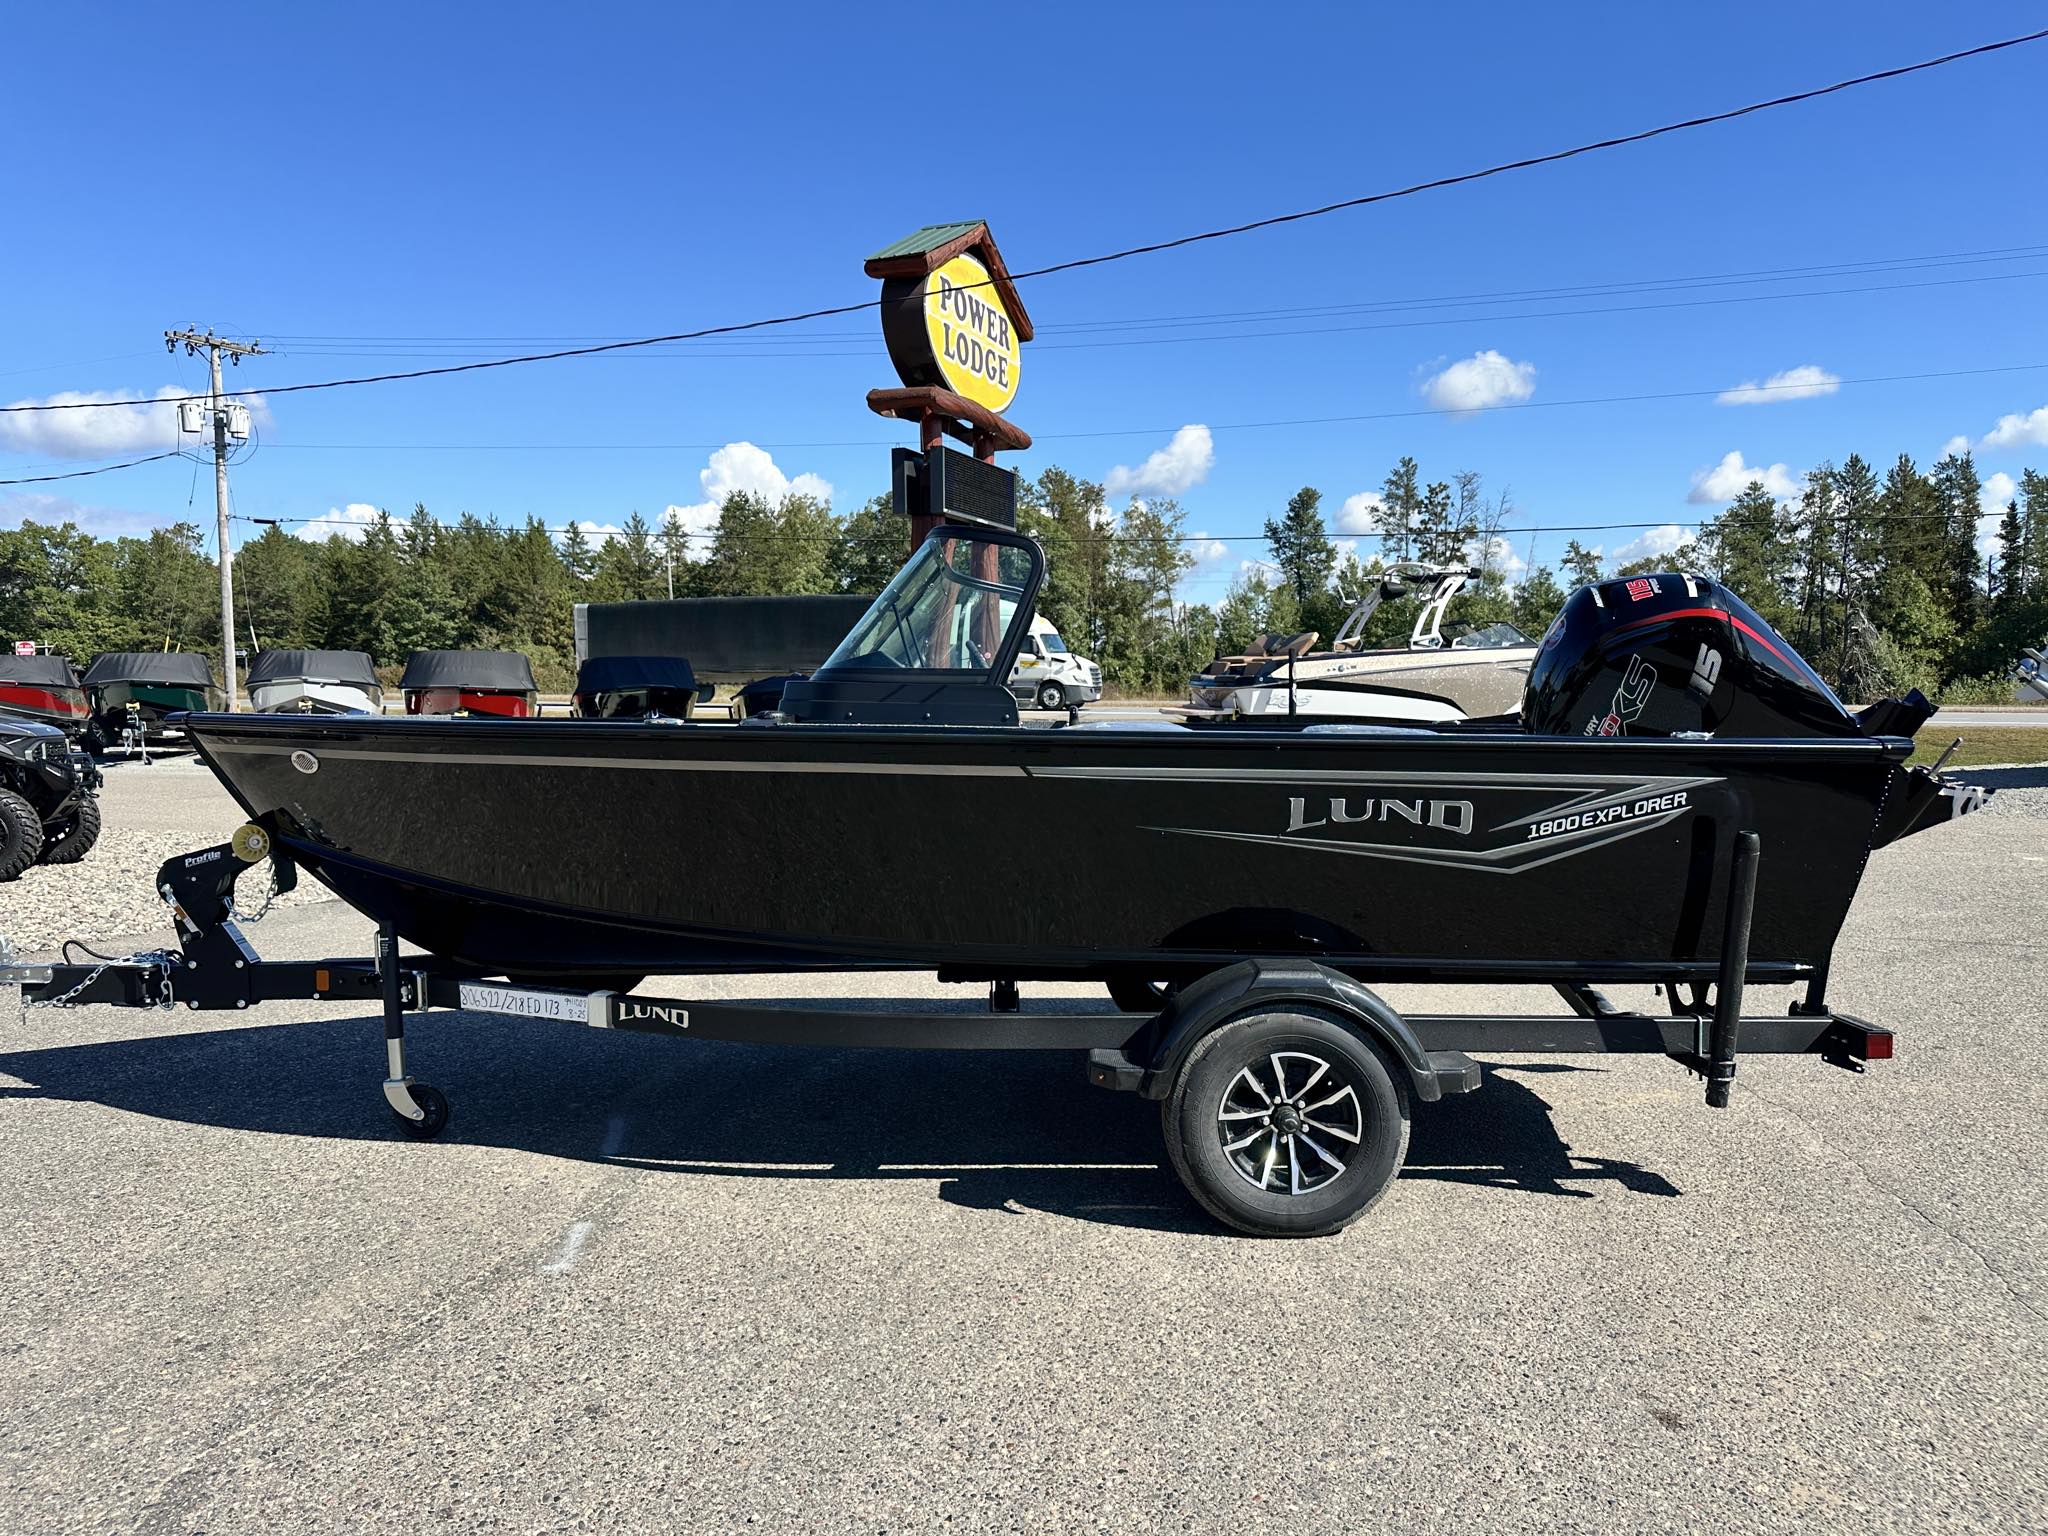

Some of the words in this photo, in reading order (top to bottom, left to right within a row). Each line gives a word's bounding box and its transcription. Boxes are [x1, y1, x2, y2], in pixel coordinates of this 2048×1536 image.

[940, 275, 1011, 351] POWER
[943, 322, 1009, 389] LODGE
[1625, 578, 1654, 602] 115
[1285, 797, 1474, 835] LUND
[1527, 815, 1580, 840] 1800
[1581, 792, 1688, 827] EXPLORER
[185, 851, 221, 867] Profile
[618, 1002, 689, 1029] LUND
